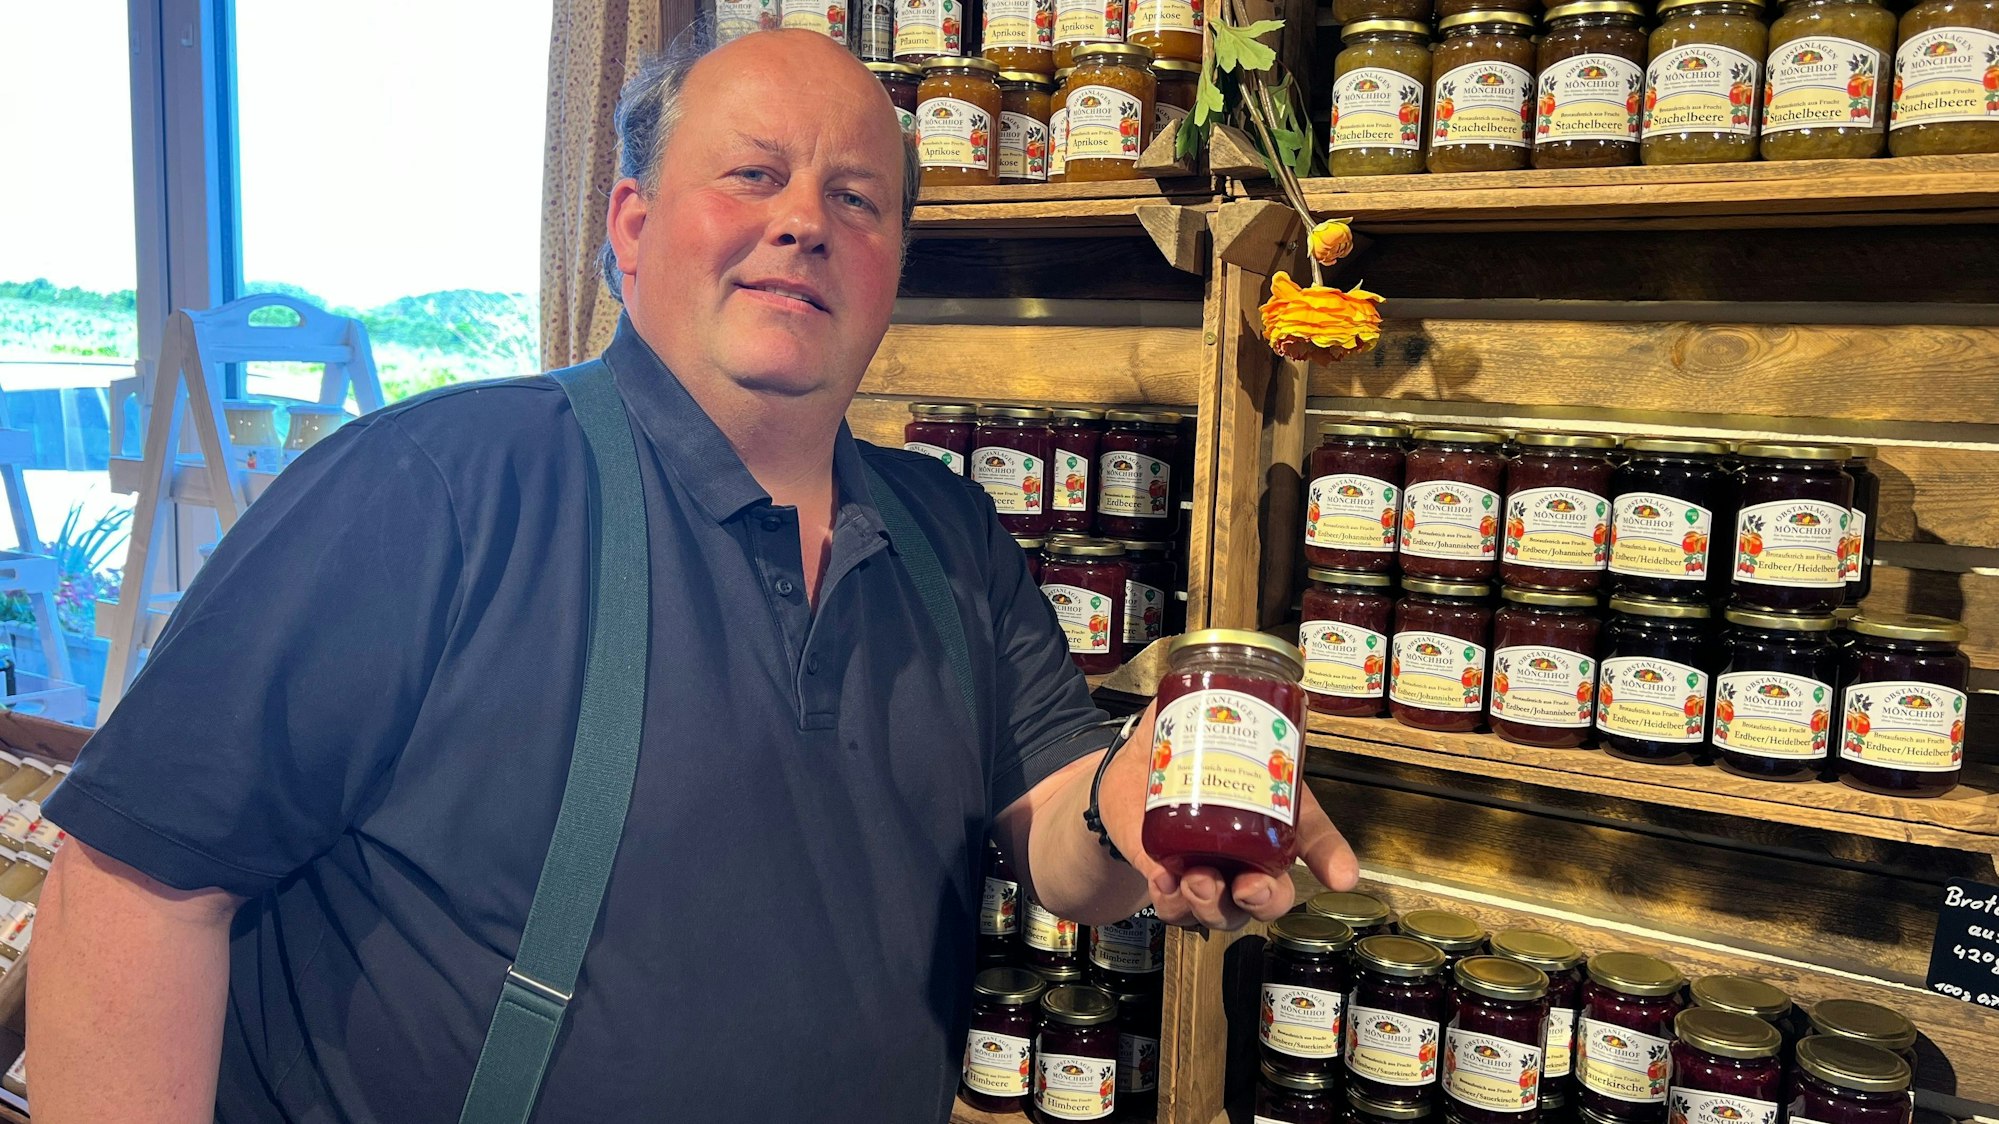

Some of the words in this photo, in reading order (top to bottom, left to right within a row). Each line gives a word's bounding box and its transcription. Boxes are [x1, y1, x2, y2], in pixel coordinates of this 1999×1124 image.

[1142, 11, 1181, 21] Aprikose
[992, 29, 1026, 38] Aprikose
[1061, 23, 1094, 33] Aprikose
[1912, 33, 1973, 58] OBSTANLAGEN
[1666, 50, 1721, 71] OBSTANLAGEN
[1781, 42, 1838, 66] OBSTANLAGEN
[1566, 59, 1620, 78] OBSTANLAGEN
[1911, 55, 1973, 69] MÖNCHHOF
[1464, 66, 1515, 85] OBSTANLAGEN
[1665, 71, 1721, 81] MÖNCHHOF
[1780, 63, 1838, 76] MÖNCHHOF
[1345, 73, 1391, 91] OBSTANLAGEN
[1565, 80, 1620, 89] MÖNCHHOF
[1345, 92, 1392, 100] MÖNCHHOF
[1464, 87, 1516, 95] MÖNCHHOF
[1073, 108, 1112, 116] MÖNCHHOF
[1900, 98, 1977, 114] Stachelbeere
[1653, 112, 1724, 126] Stachelbeere
[1769, 109, 1842, 123] Stachelbeere
[1451, 123, 1517, 134] Stachelbeere
[1555, 119, 1623, 131] Stachelbeere
[1073, 138, 1108, 148] Aprikose
[1336, 131, 1394, 141] Stachelbeere
[925, 148, 960, 158] Aprikose
[978, 466, 1016, 474] MÖNCHHOF
[1106, 470, 1143, 478] MÖNCHHOF
[1328, 479, 1374, 496] OBSTANLAGEN
[1424, 485, 1472, 503] OBSTANLAGEN
[1106, 498, 1142, 508] Erdbeere
[1327, 496, 1375, 505] MÖNCHHOF
[1535, 492, 1587, 512] OBSTANLAGEN
[1624, 497, 1674, 517] OBSTANLAGEN
[1423, 504, 1473, 513] MÖNCHHOF
[1776, 504, 1833, 524] OBSTANLAGEN
[1534, 511, 1588, 521] MÖNCHHOF
[1623, 517, 1674, 528] MÖNCHHOF
[1318, 530, 1382, 542] Erdbeer/Johannisbeer
[1774, 525, 1833, 535] MÖNCHHOF
[1412, 538, 1480, 550] Erdbeer/Johannisbeer
[1522, 545, 1593, 558] Erdbeer/Johannisbeer
[1615, 552, 1682, 566] Erdbeer/Heidelbeer
[1758, 560, 1837, 573] Erdbeer/Heidelbeer
[1313, 626, 1356, 644] OBSTANLAGEN
[1311, 641, 1357, 653] MÖNCHHOF
[1407, 636, 1454, 655] OBSTANLAGEN
[1406, 653, 1454, 665] MÖNCHHOF
[1518, 651, 1570, 670] OBSTANLAGEN
[1517, 668, 1570, 680] MÖNCHHOF
[1623, 661, 1677, 682] OBSTANLAGEN
[1304, 676, 1364, 691] Erdbeer/Johannisbeer
[1621, 679, 1677, 693] MÖNCHHOF
[1745, 676, 1803, 697] OBSTANLAGEN
[1397, 688, 1461, 702] Erdbeer/Johannisbeer
[1743, 694, 1803, 708] MÖNCHHOF
[1884, 687, 1944, 708] OBSTANLAGEN
[1505, 702, 1577, 717] Erdbeer/Johannisbeer
[1882, 706, 1944, 719] MÖNCHHOF
[1612, 714, 1685, 730] Erdbeer/Heidelbeer
[1789, 726, 1806, 734] Frucht
[1734, 730, 1811, 746] Erdbeer/Heidelbeer
[1927, 737, 1945, 745] Frucht
[1866, 741, 1950, 757] Erdbeer/Heidelbeer
[1183, 773, 1255, 792] Edbeere
[1968, 925, 1999, 944] au
[1100, 951, 1140, 964] Himbeere
[1280, 1004, 1326, 1016] MÖNCHHOF
[1271, 1034, 1332, 1050] Himbeer/Sauerkirsche
[1364, 1028, 1412, 1042] MÖNCHHOF
[1593, 1027, 1640, 1048] OBSTANLAGEN
[1592, 1041, 1641, 1058] MÖNCHHOF
[1354, 1057, 1418, 1077] Himbeer/Sauerkirsche
[1463, 1052, 1512, 1068] MÖNCHHOF
[970, 1072, 1008, 1088] Himbeere
[1053, 1072, 1093, 1081] MÖNCHHOF
[1584, 1068, 1645, 1093] Sauerkirsche
[1452, 1082, 1519, 1104] Himbeer/Sauerkirsche
[1048, 1098, 1090, 1111] Himbeere
[1699, 1099, 1754, 1119] OBSTANLAGEN
